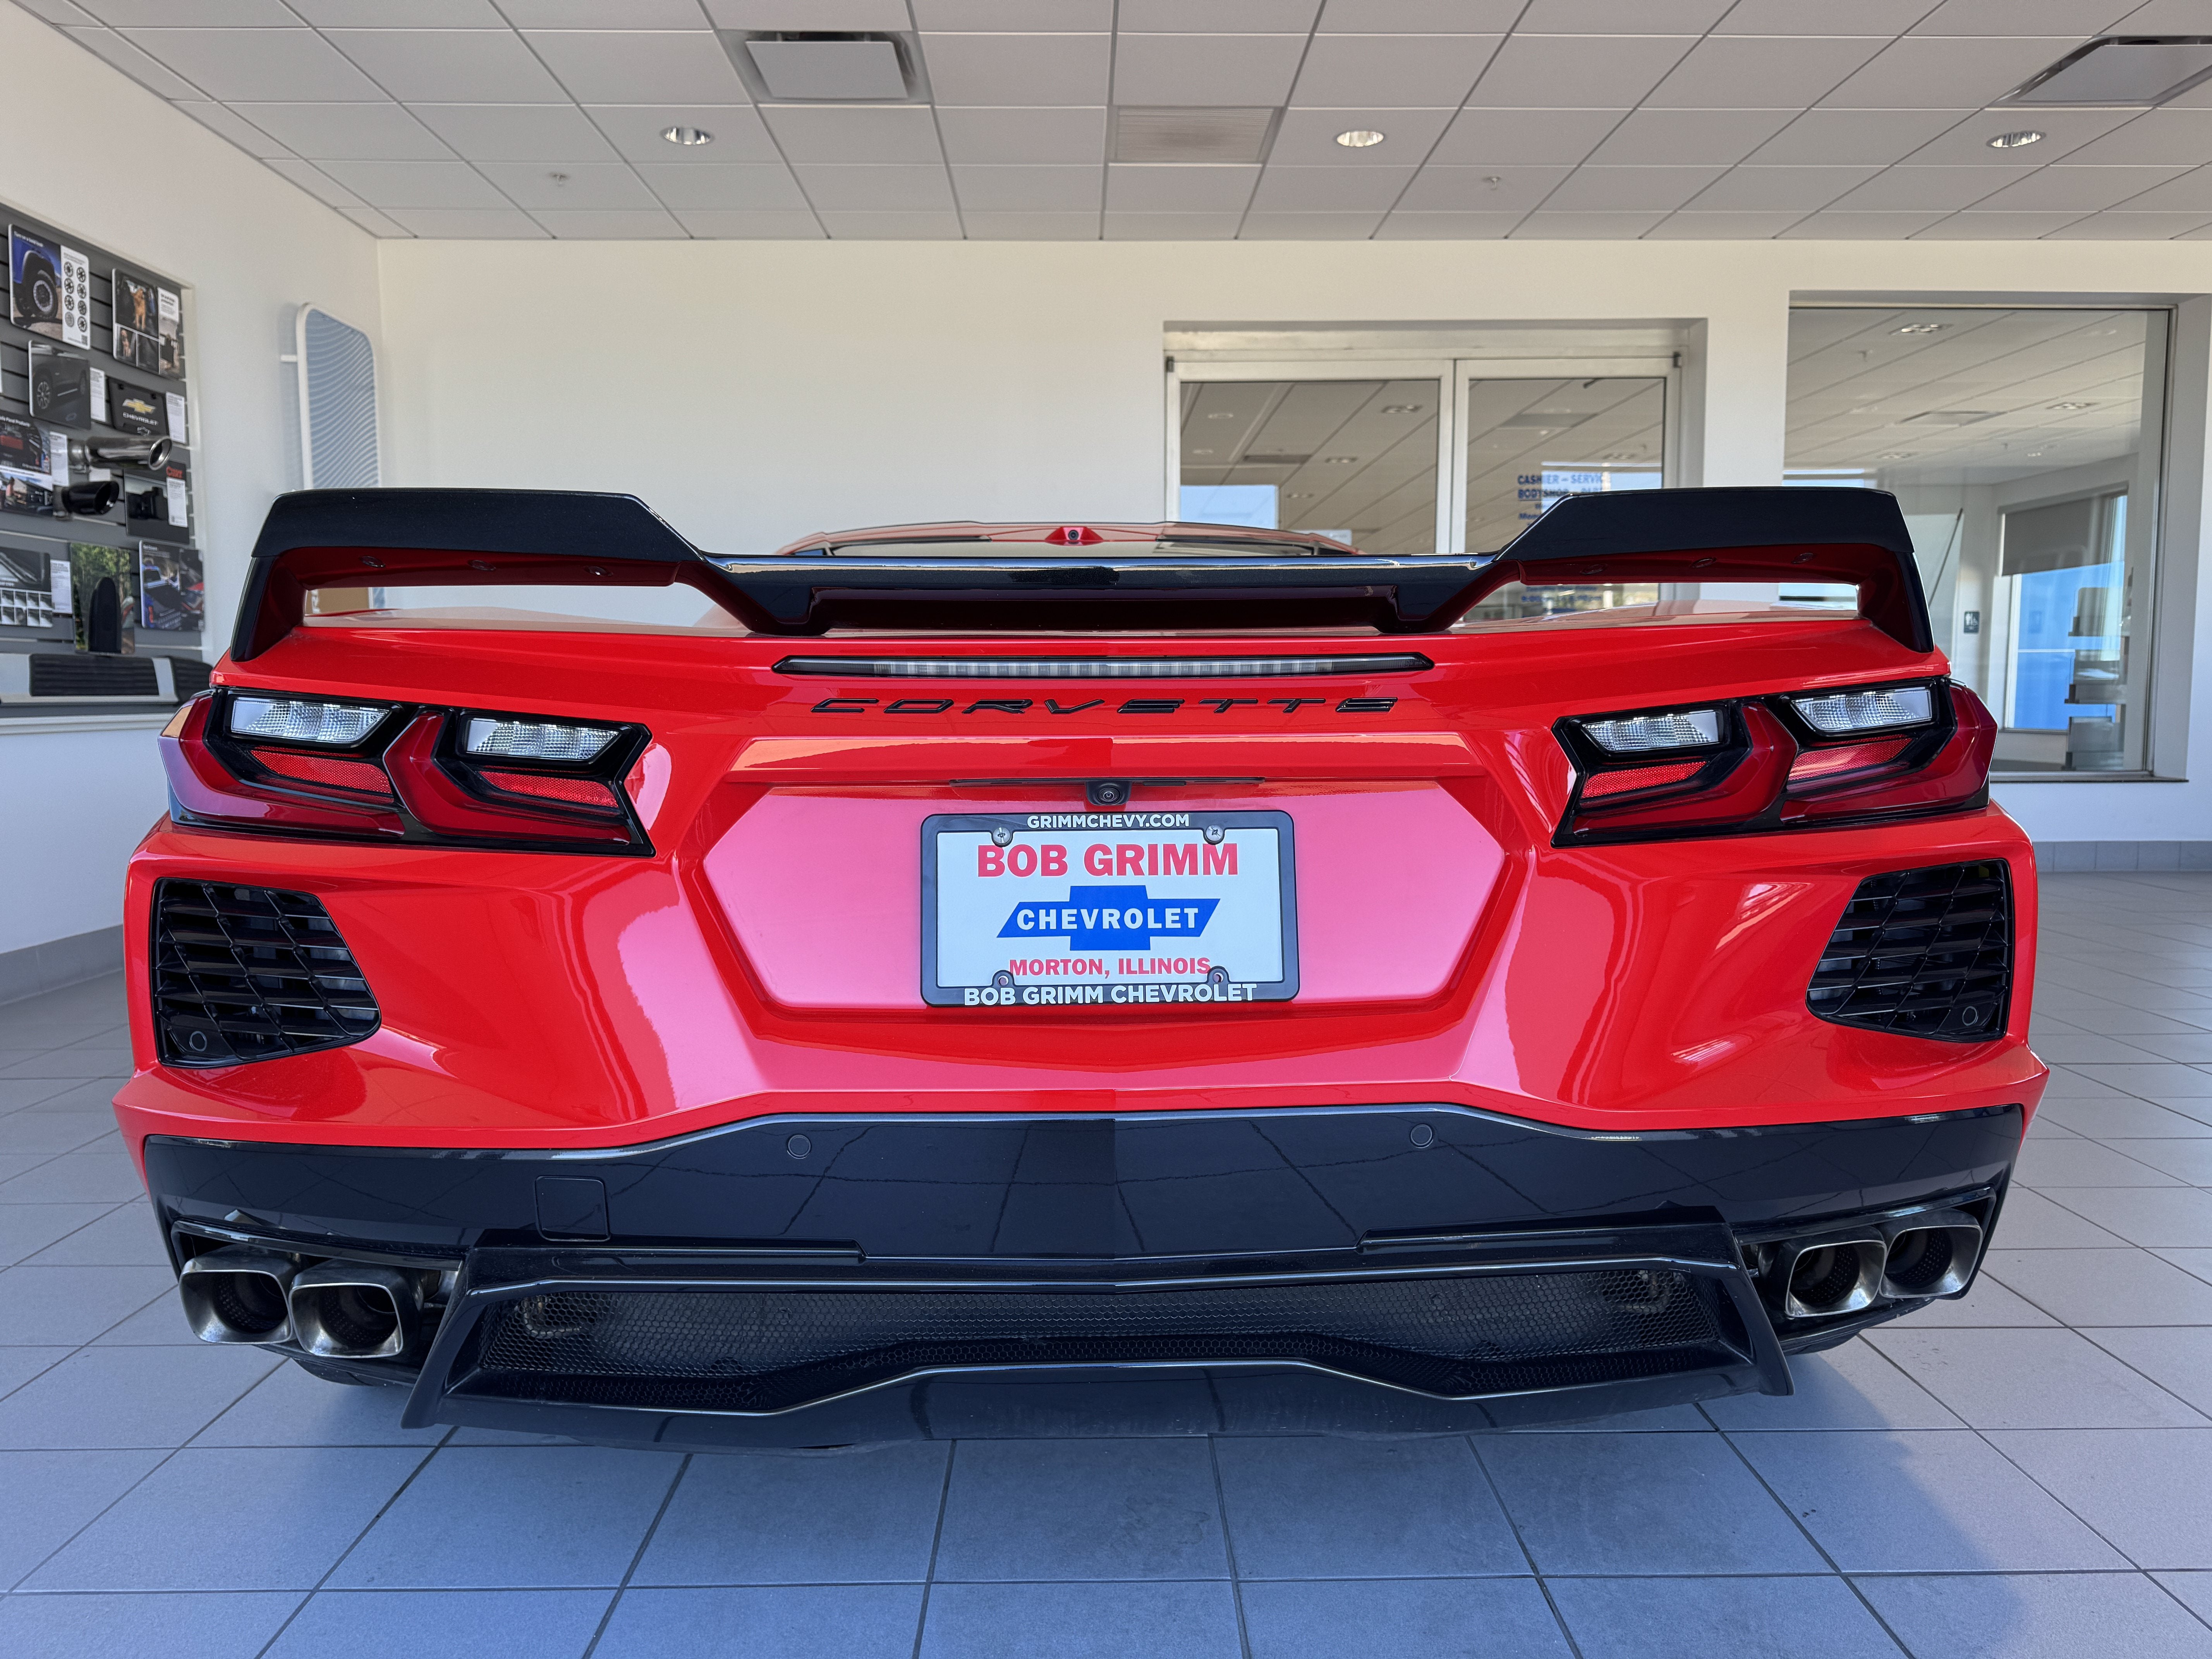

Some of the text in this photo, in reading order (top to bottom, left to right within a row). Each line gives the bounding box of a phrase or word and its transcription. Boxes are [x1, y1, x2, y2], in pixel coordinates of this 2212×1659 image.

[123, 412, 158, 425] CHEVROLET
[1518, 475, 1559, 484] CASHIER
[810, 697, 1398, 714] CORVETTE
[1026, 814, 1190, 829] GRIMMCHEVY.COM
[977, 843, 1238, 878] BOB GRIMM
[1016, 907, 1199, 931] CHEVROLET
[1009, 957, 1211, 979] MORTON, ILLINOIS
[963, 983, 1257, 1006] BOB GRIMM CHEVROLET
